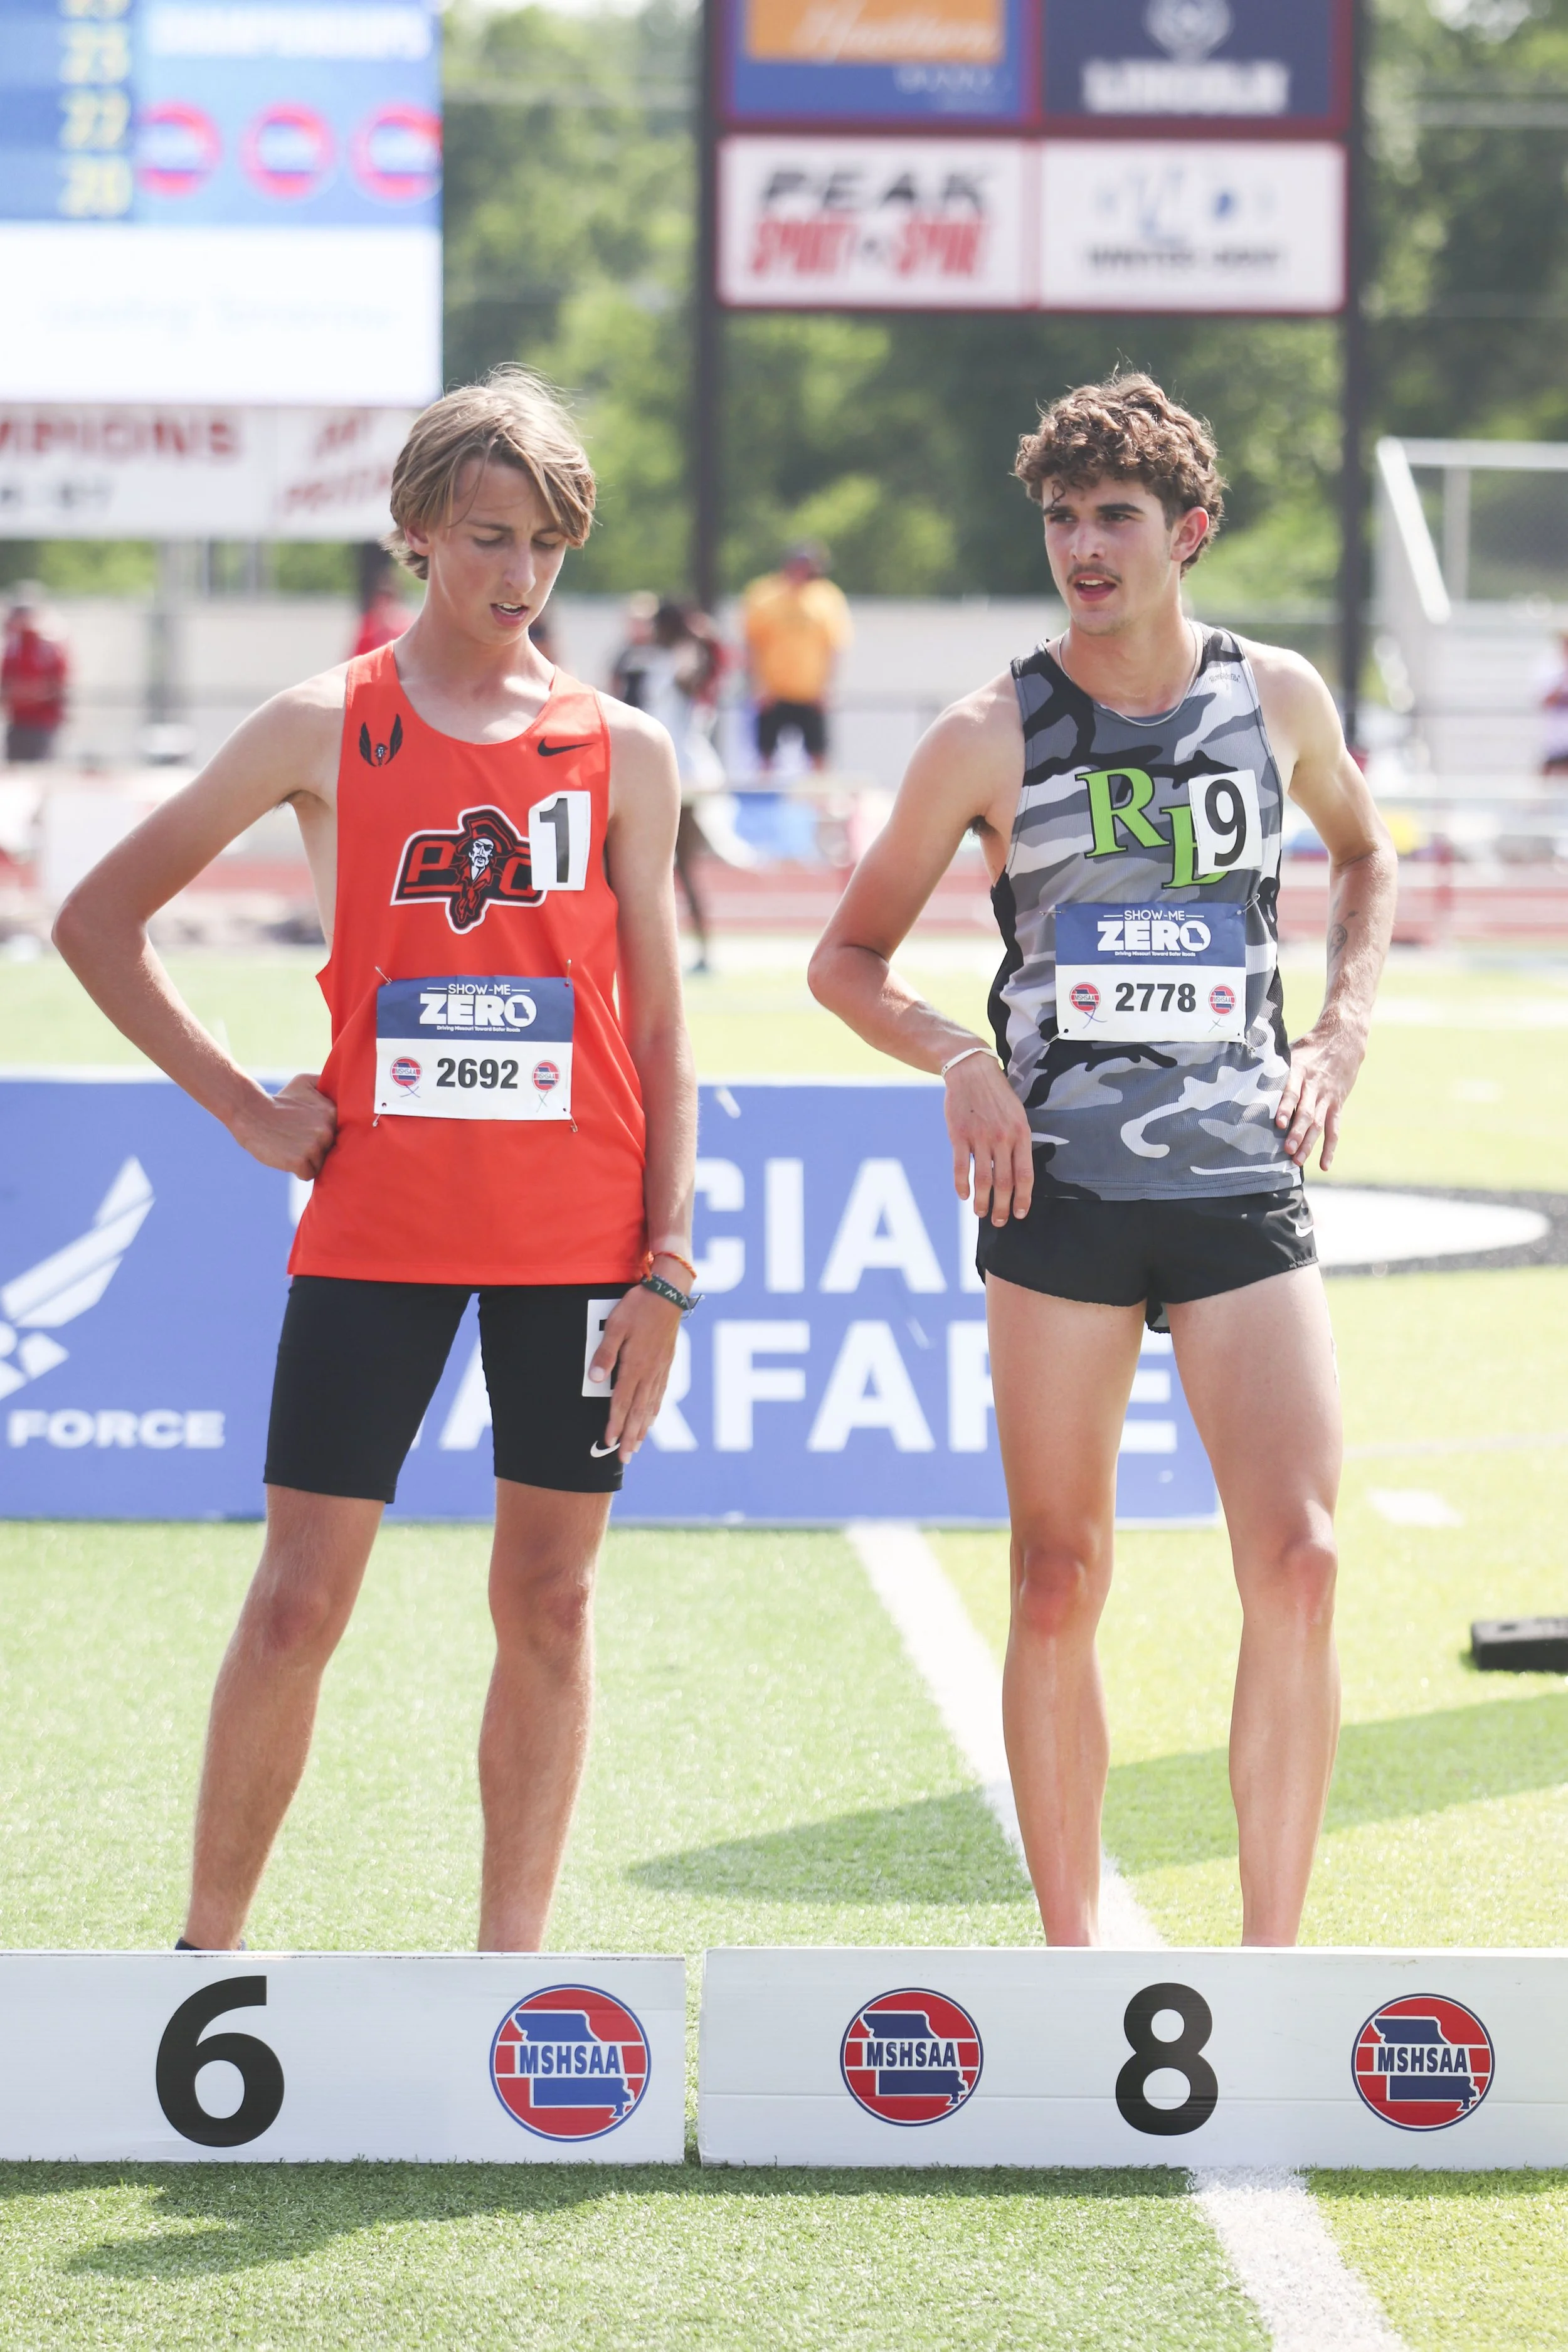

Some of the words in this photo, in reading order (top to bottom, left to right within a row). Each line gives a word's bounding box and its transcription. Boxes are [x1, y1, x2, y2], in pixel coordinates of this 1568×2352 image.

[760, 167, 992, 213] PEAK
[1205, 779, 1247, 867] 9
[539, 798, 569, 883] 1
[1124, 909, 1185, 921] SHOW-ME
[1098, 920, 1211, 951] ZERO
[448, 984, 511, 995] SHOW-ME
[1115, 982, 1196, 1012] 2778
[420, 993, 537, 1027] ZERO
[437, 1057, 519, 1089] 2692
[8, 1409, 226, 1449] FORCE
[156, 1976, 285, 2148] 6
[520, 2045, 620, 2074] MSHSAA
[867, 2042, 956, 2067] MSHSAA
[1115, 1982, 1219, 2136] 8
[1378, 2047, 1468, 2073] MSHSAA
